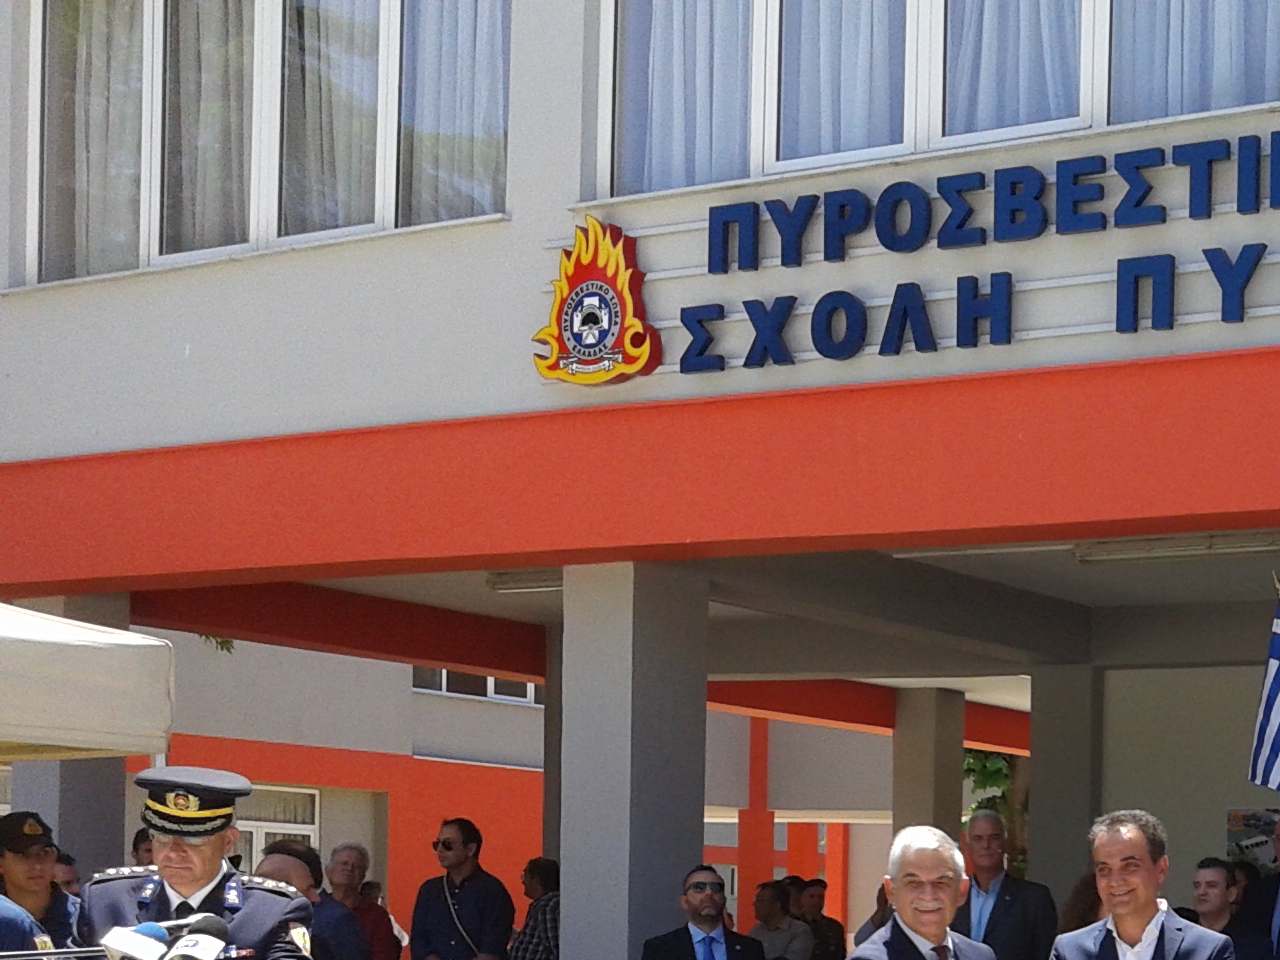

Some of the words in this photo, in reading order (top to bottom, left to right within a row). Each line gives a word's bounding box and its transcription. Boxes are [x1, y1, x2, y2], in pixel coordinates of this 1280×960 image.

[563, 282, 610, 332] ΠΥΡΟΣΒΕΣΤΙΚΟ
[609, 295, 620, 327] ΣΩΜΑ
[679, 271, 1013, 375] ΣΧΟΛΗ
[571, 342, 609, 358] ΕΛΛΑΔΑΣ
